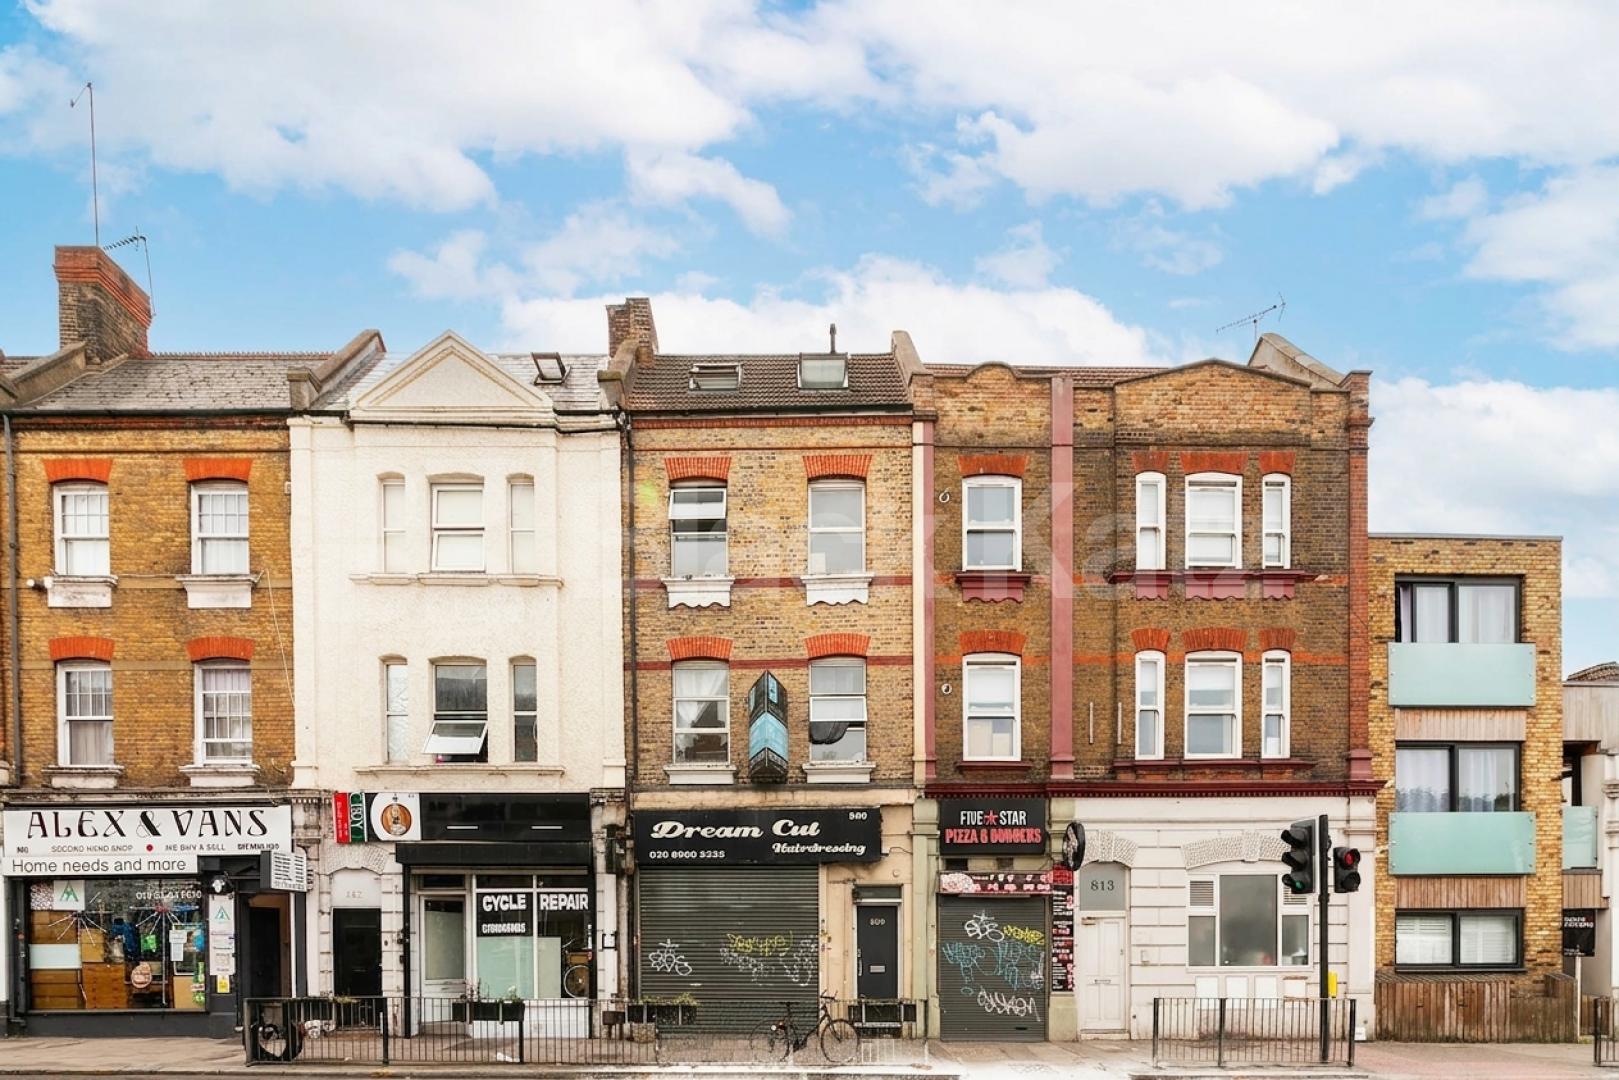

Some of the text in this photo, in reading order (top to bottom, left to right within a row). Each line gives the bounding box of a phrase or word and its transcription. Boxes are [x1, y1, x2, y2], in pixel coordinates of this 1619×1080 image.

[27, 809, 268, 839] ALEX & VANS
[1000, 811, 1027, 825] STAR
[650, 821, 764, 838] Dream
[649, 850, 669, 859] 020
[12, 858, 187, 872] Home needs and more
[1090, 880, 1115, 892] 813
[482, 894, 589, 911] CYCLE REPAIR
